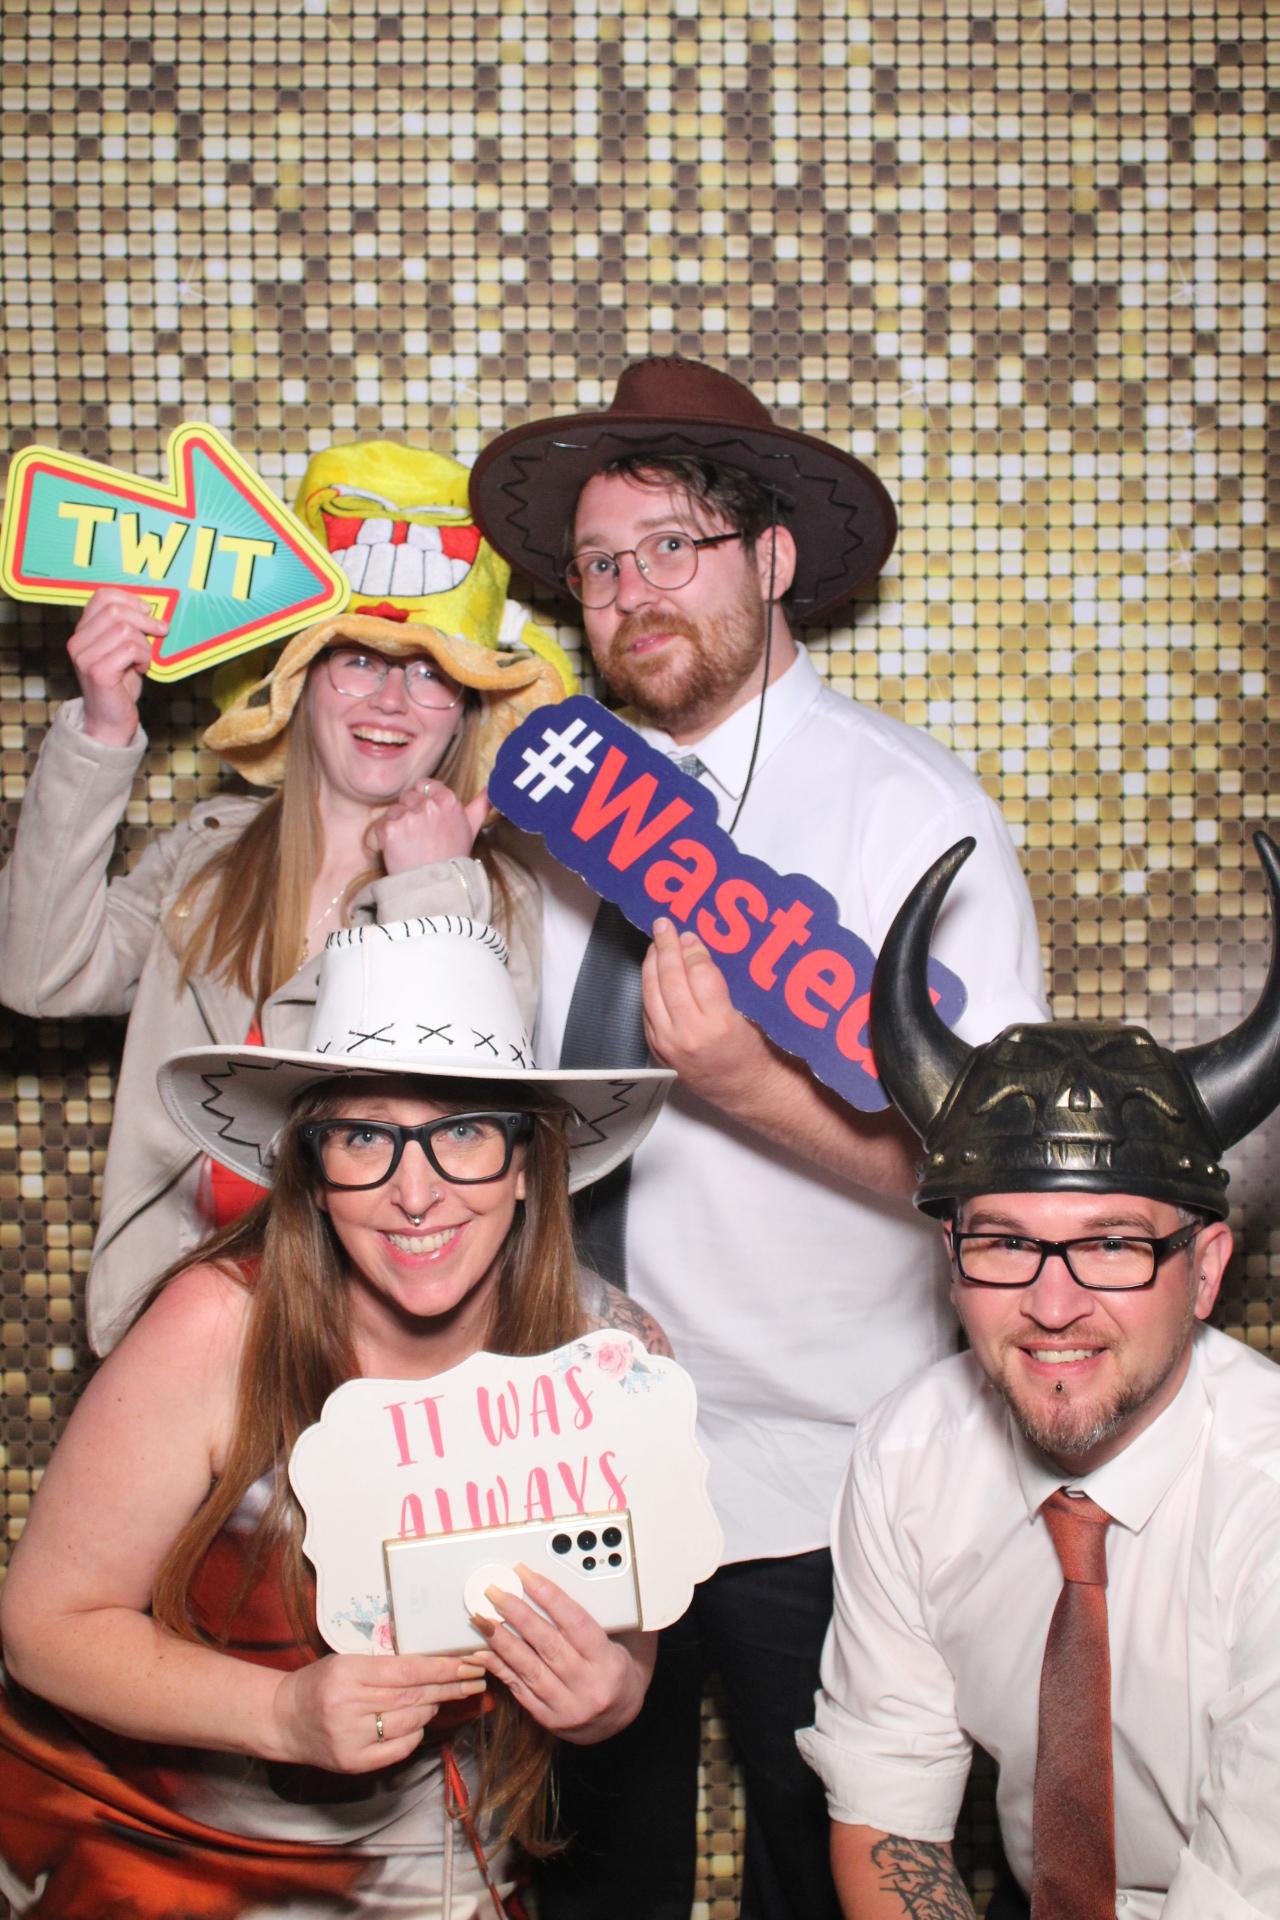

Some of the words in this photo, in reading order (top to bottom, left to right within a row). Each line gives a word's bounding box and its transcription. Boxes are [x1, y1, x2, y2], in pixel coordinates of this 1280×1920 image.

[58, 502, 277, 601] TWIT
[383, 1395, 445, 1467] IT
[476, 1366, 594, 1447] WAS
